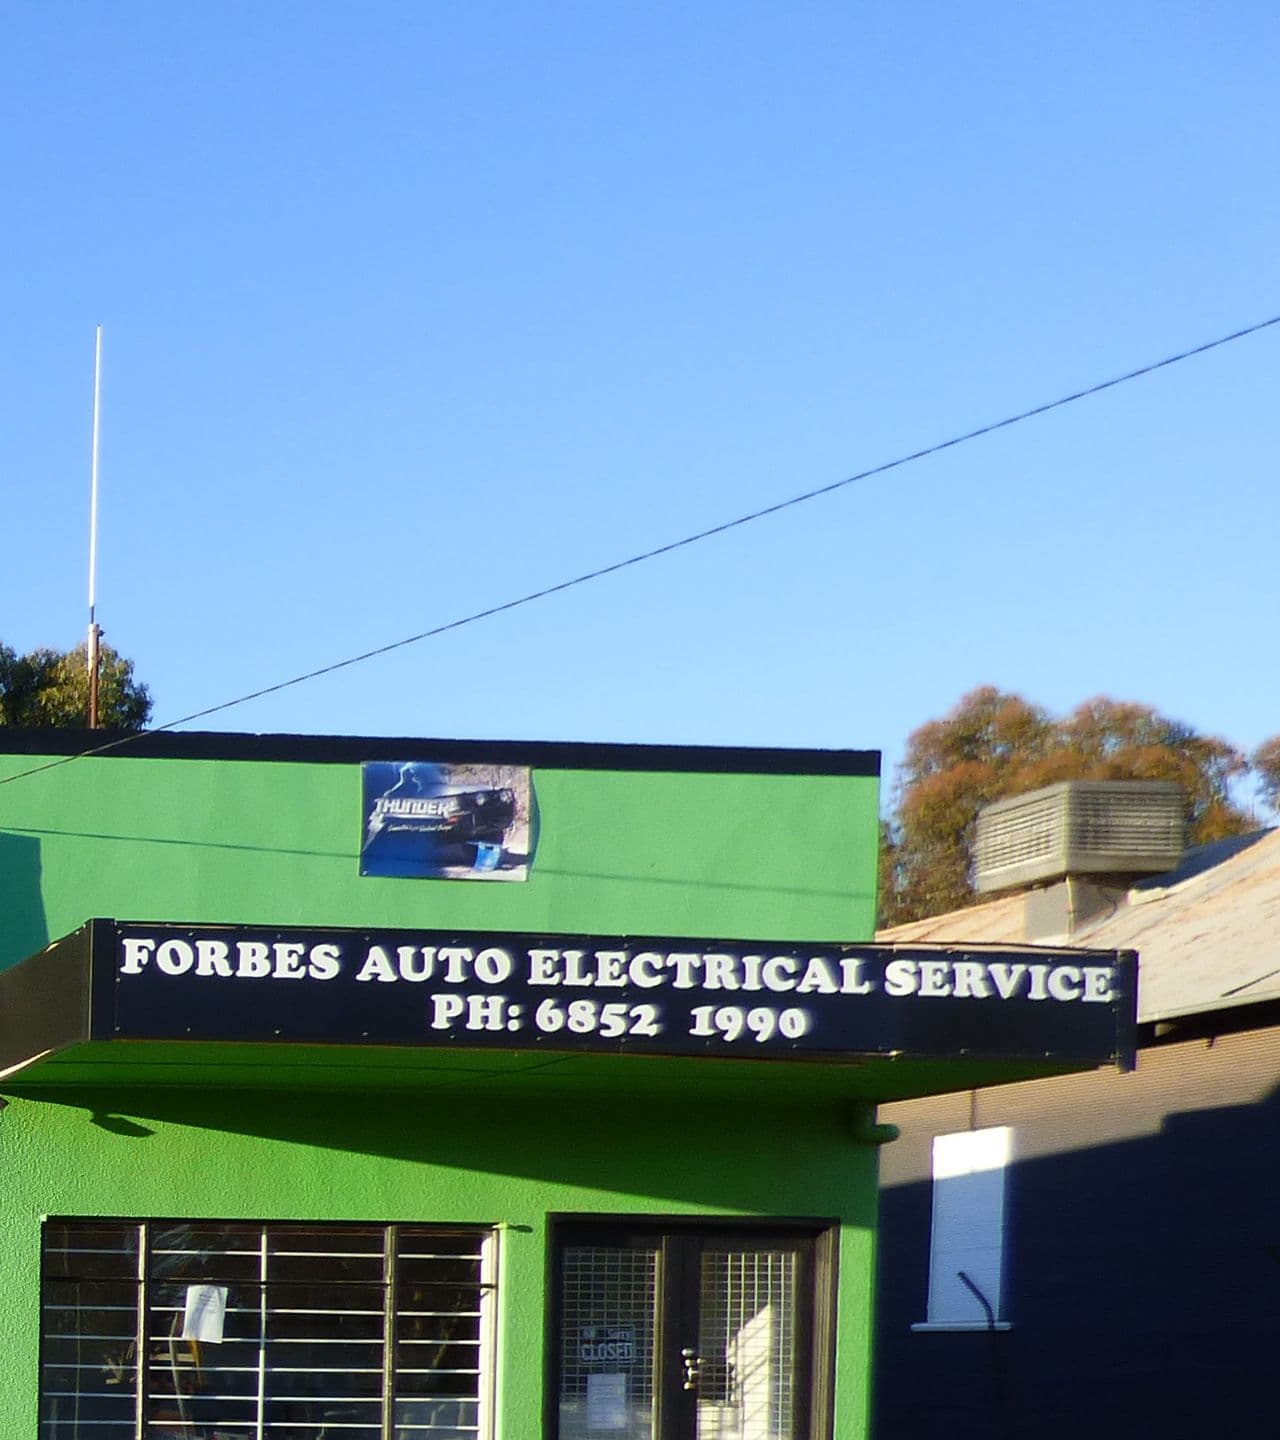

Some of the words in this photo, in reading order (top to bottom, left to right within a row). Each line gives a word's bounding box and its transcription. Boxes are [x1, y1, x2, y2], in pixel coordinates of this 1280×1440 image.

[120, 938, 341, 980] FORBES
[355, 946, 513, 983] AUTO
[527, 949, 871, 995] ELECTRICAL
[884, 960, 1116, 1003] SERVICE
[431, 994, 521, 1031] PH:
[535, 999, 660, 1037] 6852
[689, 1006, 808, 1042] 1990
[581, 1343, 633, 1361] CLOSED
